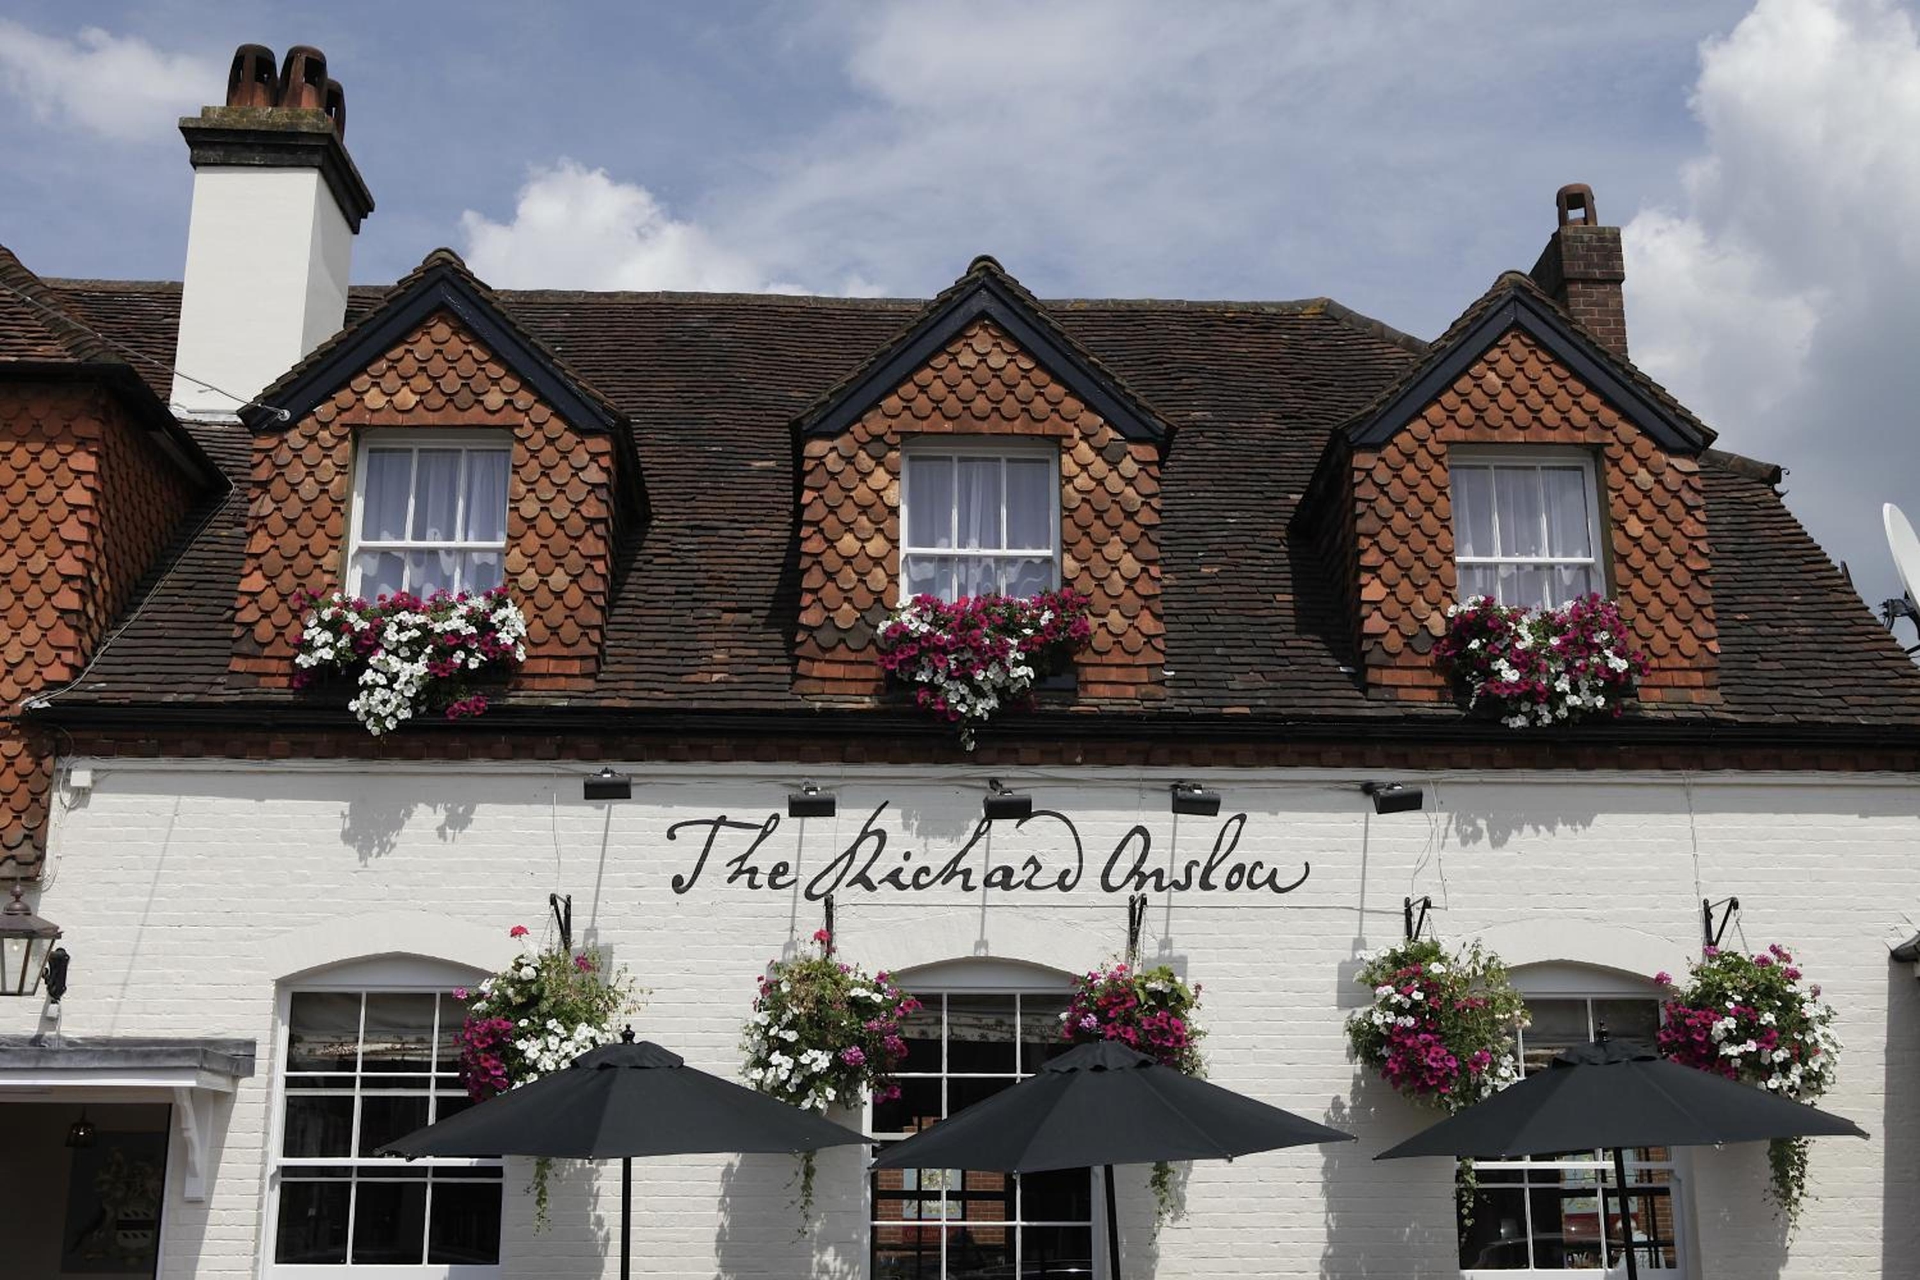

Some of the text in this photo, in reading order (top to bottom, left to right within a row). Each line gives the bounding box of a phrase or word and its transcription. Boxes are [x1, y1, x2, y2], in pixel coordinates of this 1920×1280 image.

[666, 799, 1310, 901] The Richard Onslow
